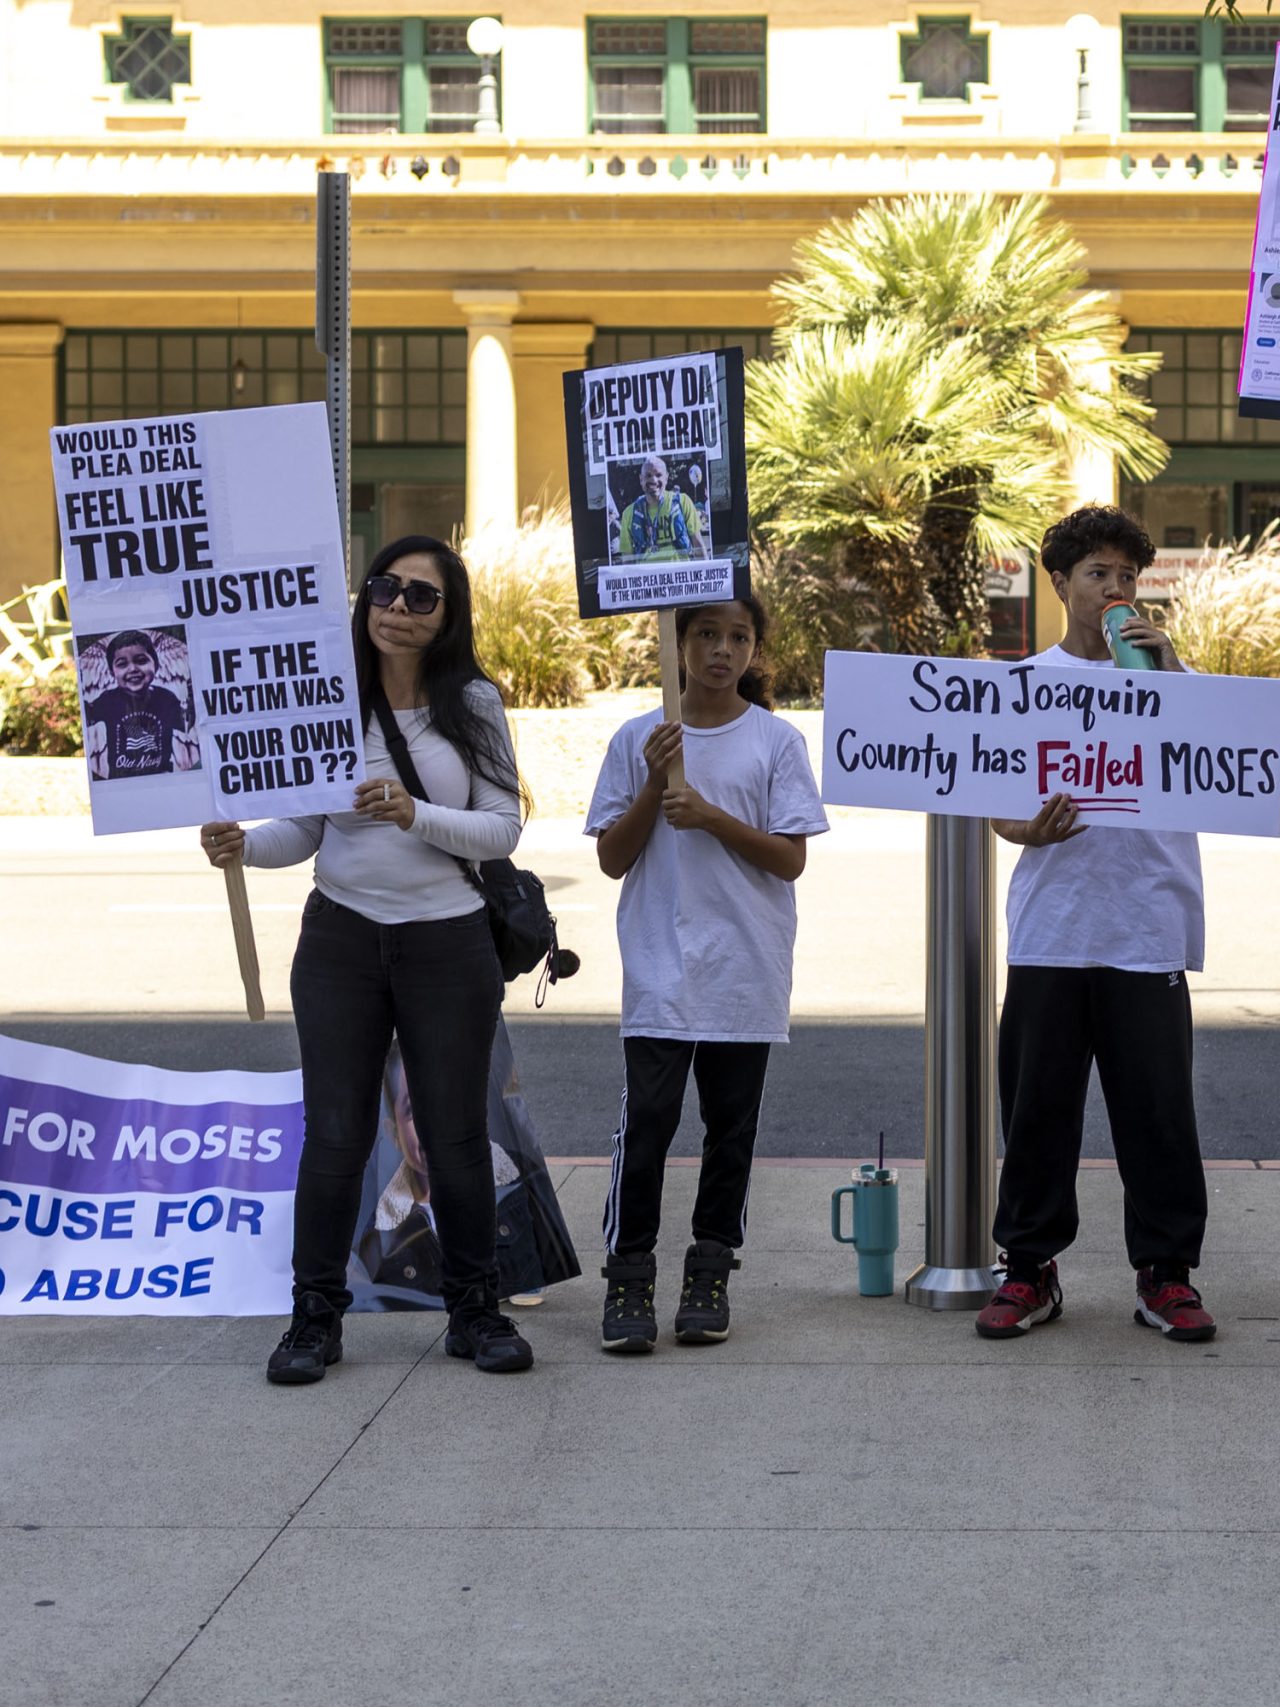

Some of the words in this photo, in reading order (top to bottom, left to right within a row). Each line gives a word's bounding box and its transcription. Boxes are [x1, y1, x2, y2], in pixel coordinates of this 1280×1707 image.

[589, 370, 676, 420] DEPUTY
[681, 364, 716, 407] DA
[56, 427, 138, 455] WOULD
[143, 422, 197, 448] THIS
[591, 415, 656, 464] ELTON
[661, 408, 718, 456] GRAU
[72, 452, 133, 479] PLEA
[140, 447, 202, 473] DEAL
[64, 487, 134, 530] FEEL
[139, 480, 207, 522] LIKE
[70, 523, 213, 582] TRUE
[175, 566, 320, 619] JUSTICE
[605, 578, 627, 590] WOULD
[628, 576, 642, 589] THIS
[643, 575, 658, 587] PLEA
[658, 573, 674, 585] DEAL
[674, 571, 688, 584] FEEL
[690, 570, 703, 582] LIKE
[704, 567, 729, 580] JUSTICE
[611, 591, 619, 602] IF
[619, 590, 630, 602] THE
[631, 587, 652, 600] VICTIM
[652, 586, 667, 599] WAS
[667, 585, 684, 598] YOUR
[684, 583, 700, 596] OWN
[700, 580, 724, 594] CHILD??
[210, 648, 243, 684] IF
[250, 641, 320, 679] THE
[202, 683, 289, 717] VICTIM
[291, 675, 346, 708] WAS
[909, 661, 1001, 714] San
[1008, 665, 1161, 732] Joaquin
[116, 755, 135, 769] Old
[137, 754, 162, 769] Navy
[214, 728, 288, 762] YOUR
[290, 718, 355, 753] OWN
[219, 756, 315, 795] CHILD
[323, 749, 358, 783] ??
[836, 728, 957, 796] County
[972, 733, 1027, 774] has
[1037, 741, 1143, 795] Failed
[1161, 741, 1279, 798] MOSES
[2, 1107, 96, 1160] FOR
[112, 1125, 283, 1164] MOSES
[154, 1195, 264, 1237] FOR
[19, 1257, 214, 1302] ABUSE
